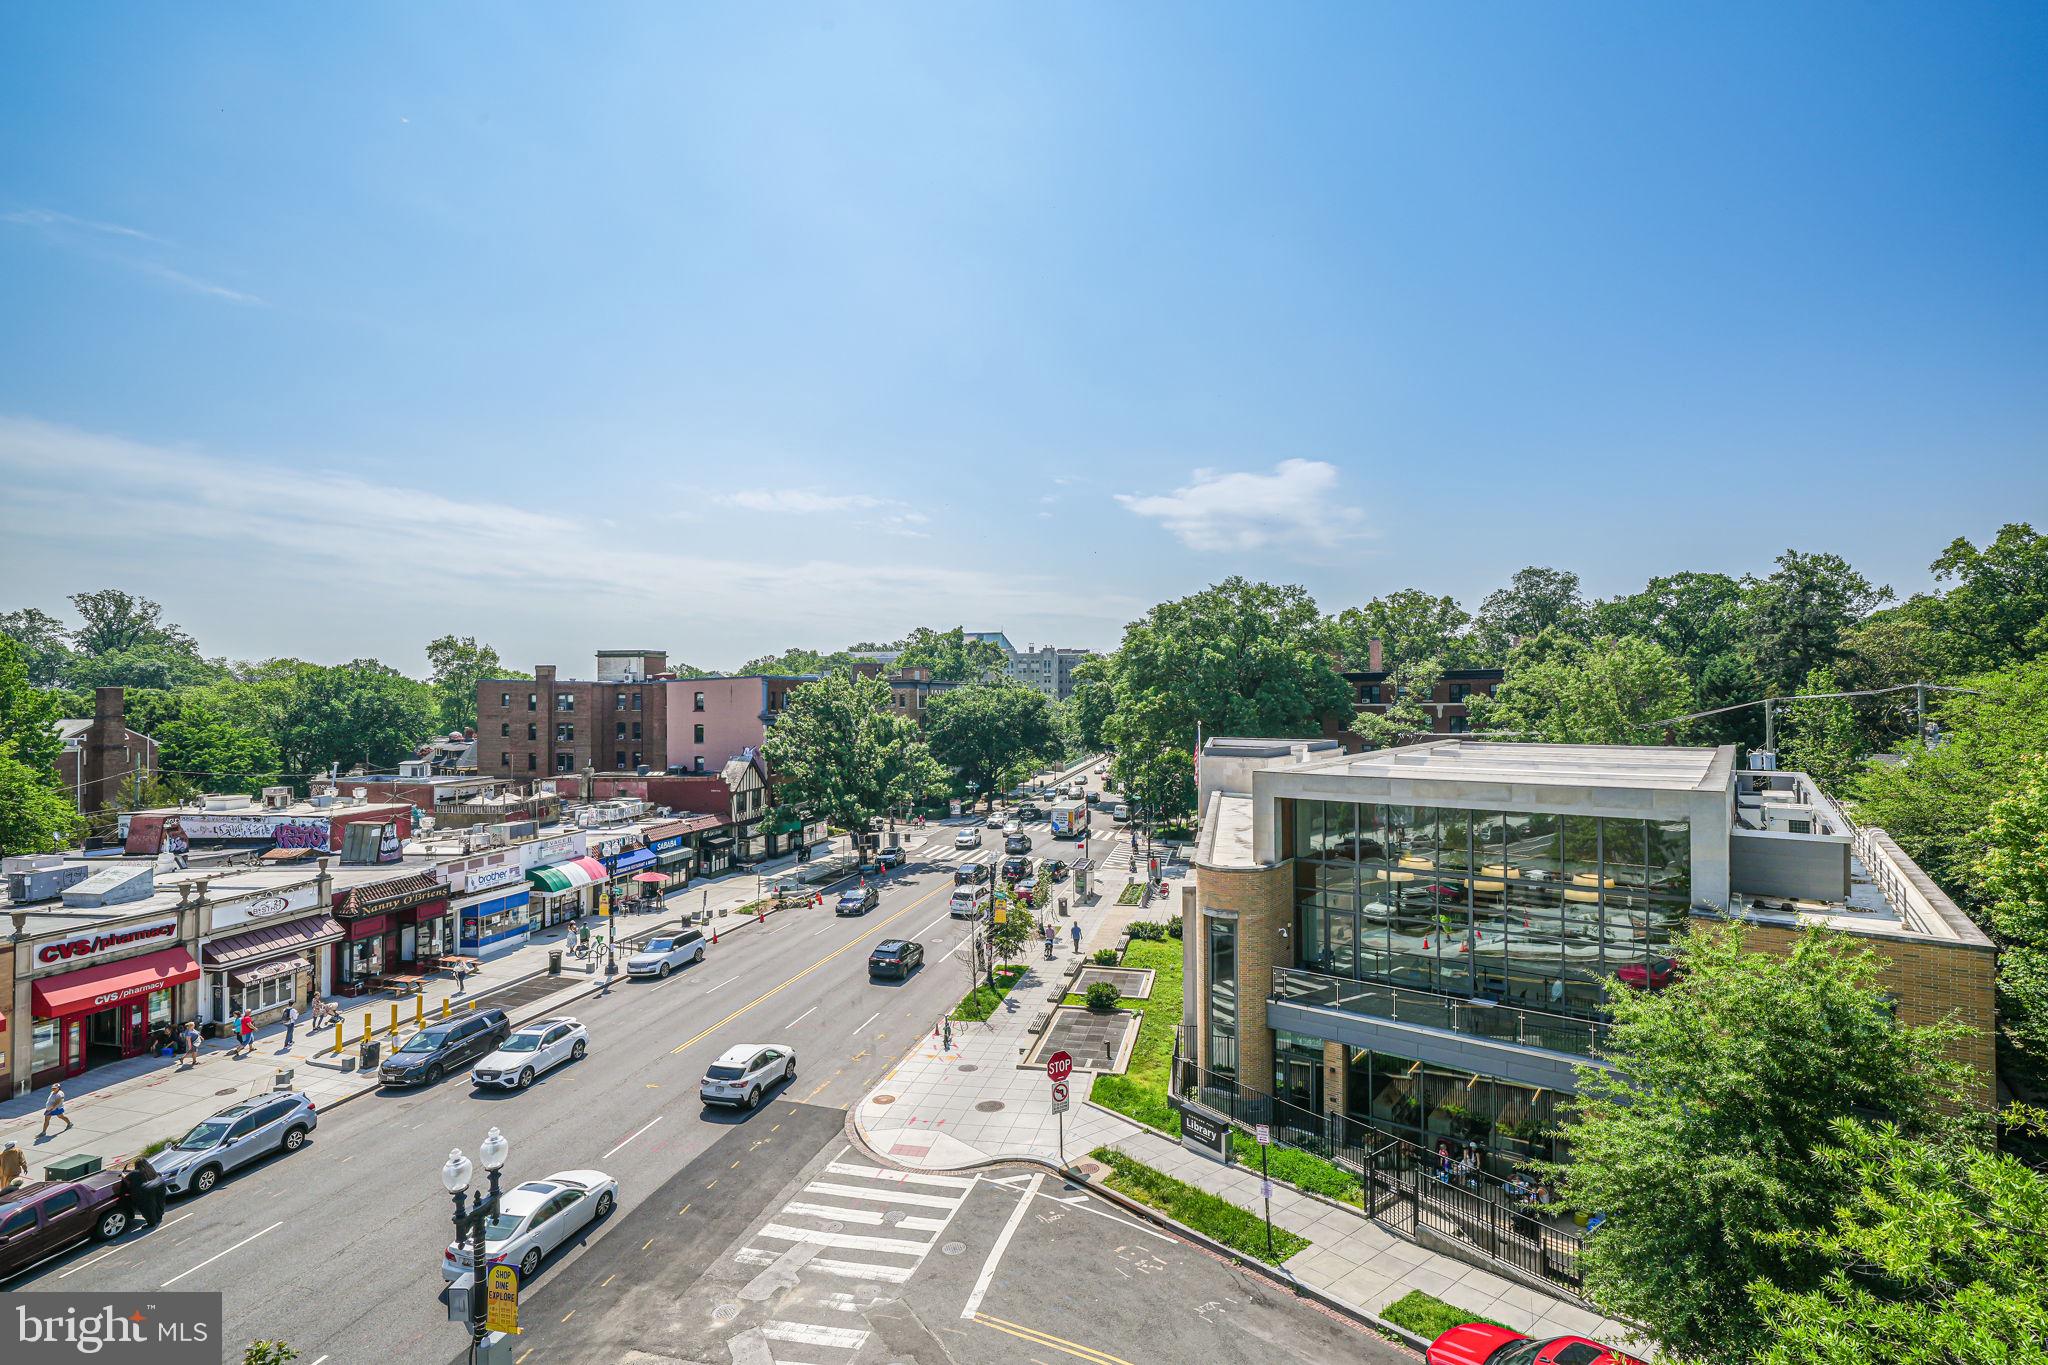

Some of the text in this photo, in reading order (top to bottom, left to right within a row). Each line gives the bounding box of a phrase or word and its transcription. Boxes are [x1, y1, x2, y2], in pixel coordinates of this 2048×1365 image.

[656, 839, 677, 851] SABABA
[478, 870, 508, 884] brother
[362, 888, 448, 915] Nanny O'Briens
[38, 923, 177, 963] CVS/pharmacy
[94, 981, 165, 1006] CVS/pharmacy
[1049, 1059, 1071, 1075] STOP
[1186, 1118, 1217, 1141] Library
[496, 1270, 511, 1279] SHOP
[496, 1281, 509, 1290] DINE
[489, 1291, 515, 1302] EXPLORE
